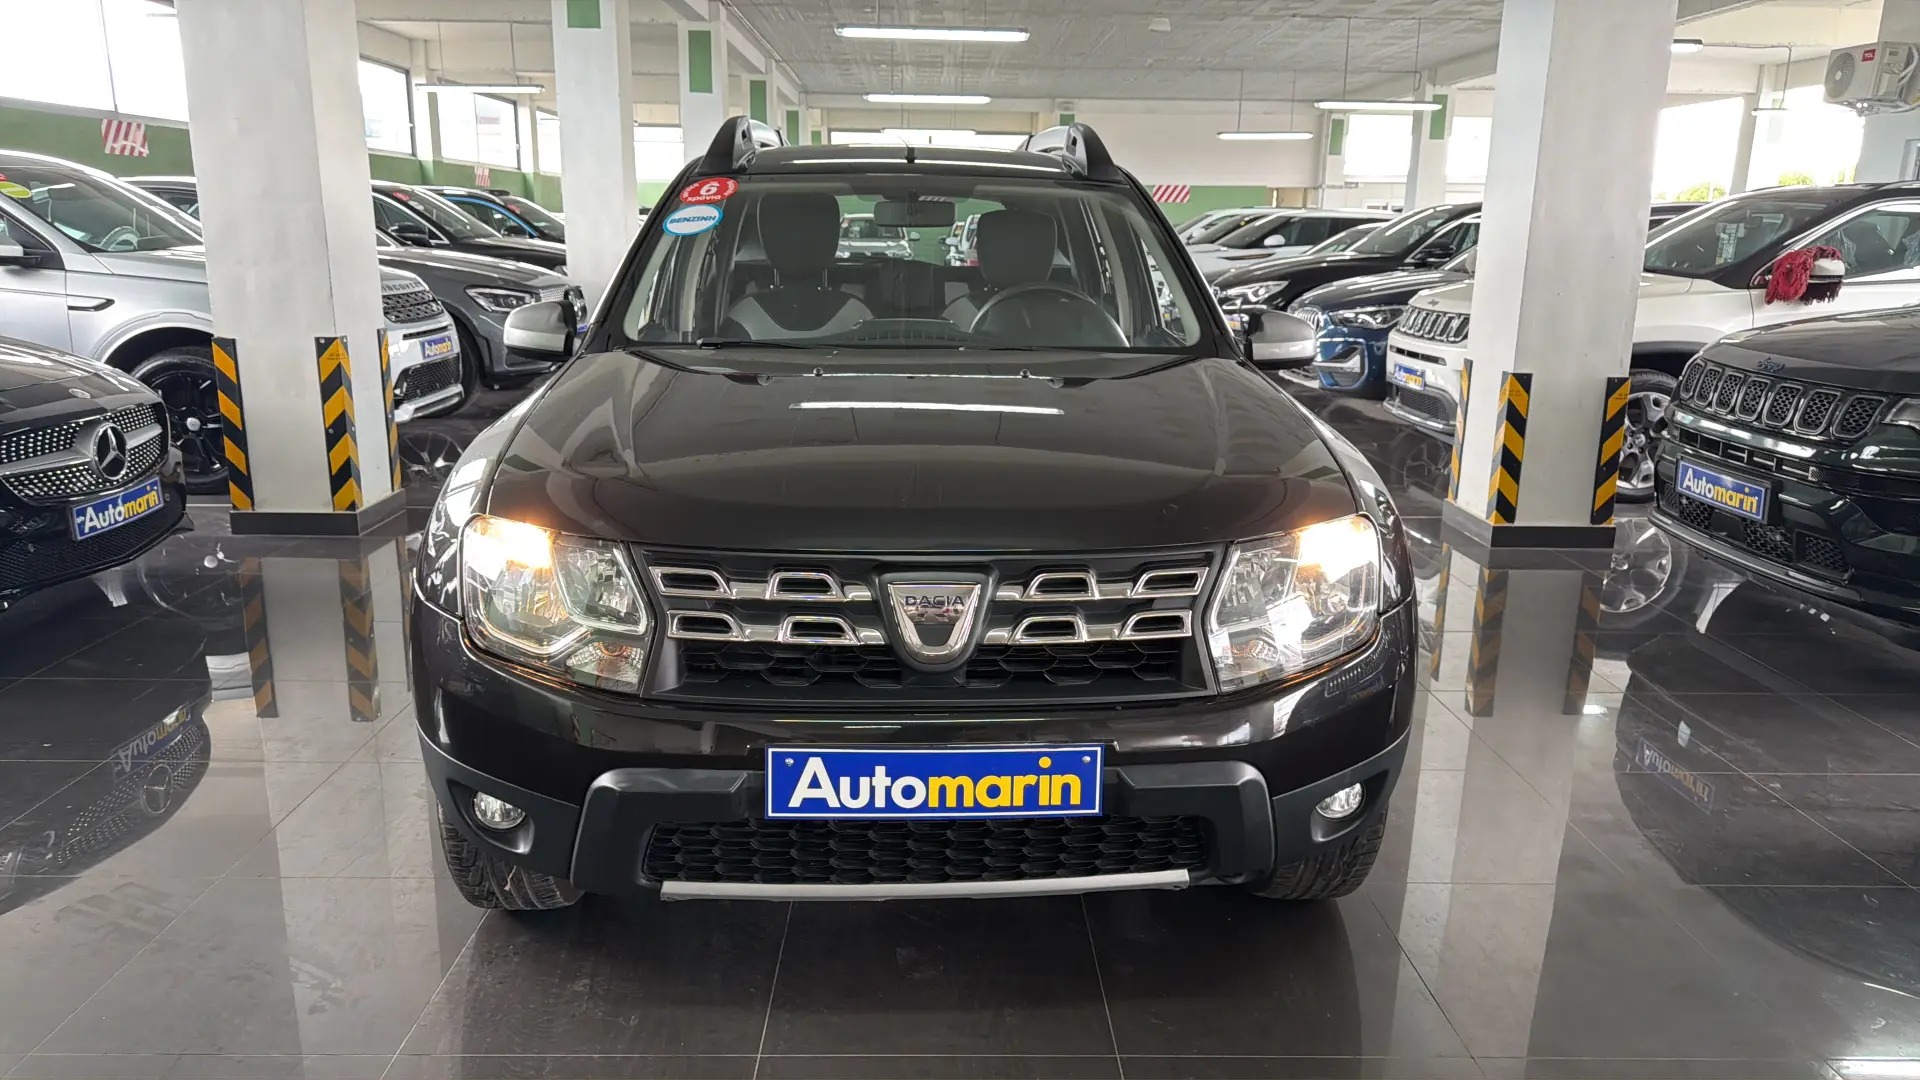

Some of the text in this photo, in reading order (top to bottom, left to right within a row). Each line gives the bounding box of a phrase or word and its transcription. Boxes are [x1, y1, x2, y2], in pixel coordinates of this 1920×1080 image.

[700, 181, 720, 195] 6
[84, 485, 159, 533] Automarin
[1682, 467, 1757, 513] Automarin
[904, 595, 965, 607] DACIA
[788, 757, 1081, 809] Automarin
